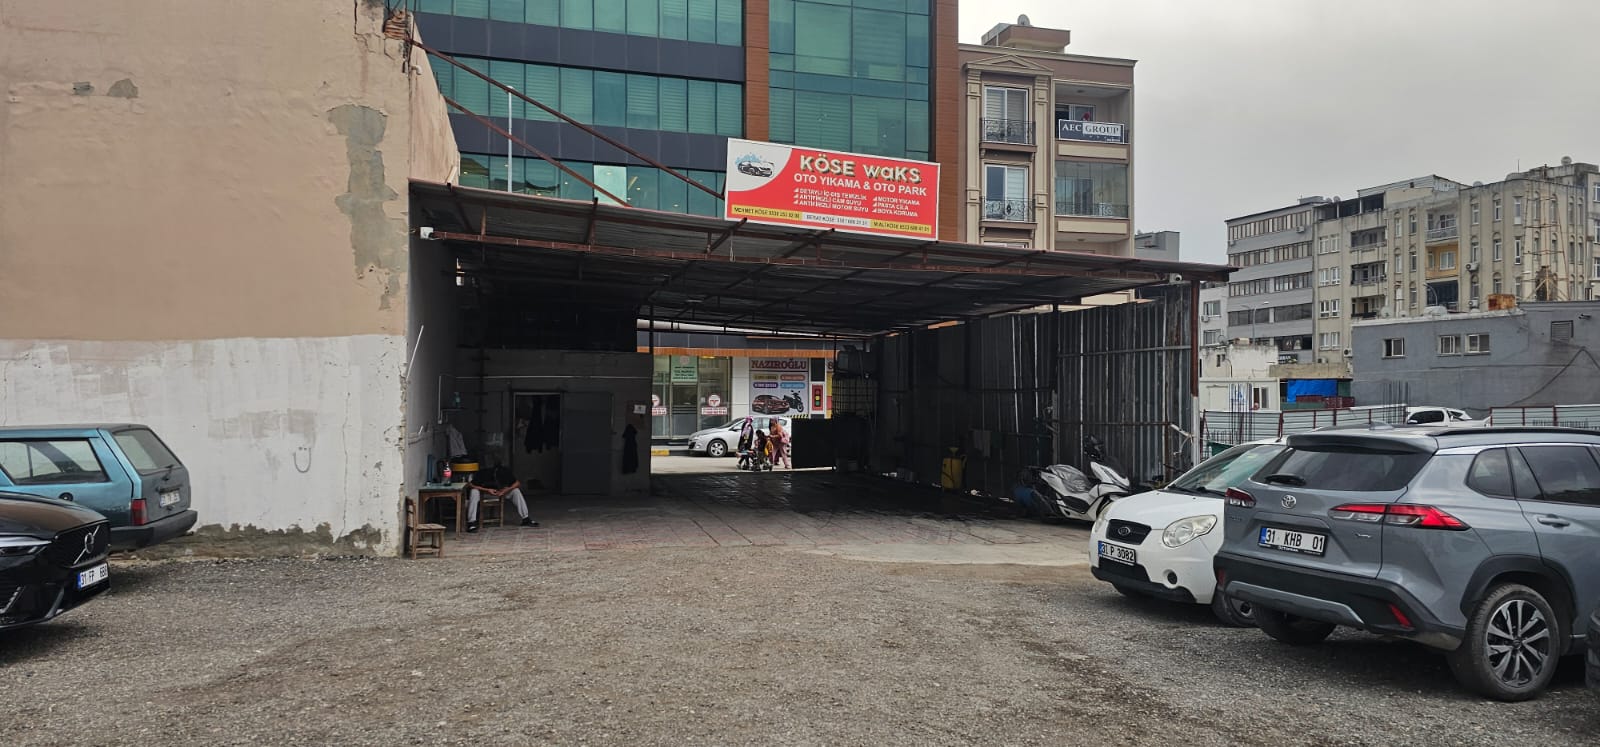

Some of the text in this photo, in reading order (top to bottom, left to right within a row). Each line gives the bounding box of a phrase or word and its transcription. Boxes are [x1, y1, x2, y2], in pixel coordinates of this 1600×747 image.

[1085, 125, 1119, 134] GROUP
[799, 153, 855, 175] KÖSE
[793, 173, 926, 195] OTO YIKAMA & OTO PARK
[1265, 529, 1324, 550] 31 KHB 01
[1102, 544, 1108, 555] 31
[1110, 547, 1115, 556] P
[1116, 548, 1134, 561] 3082
[80, 573, 87, 585] 31
